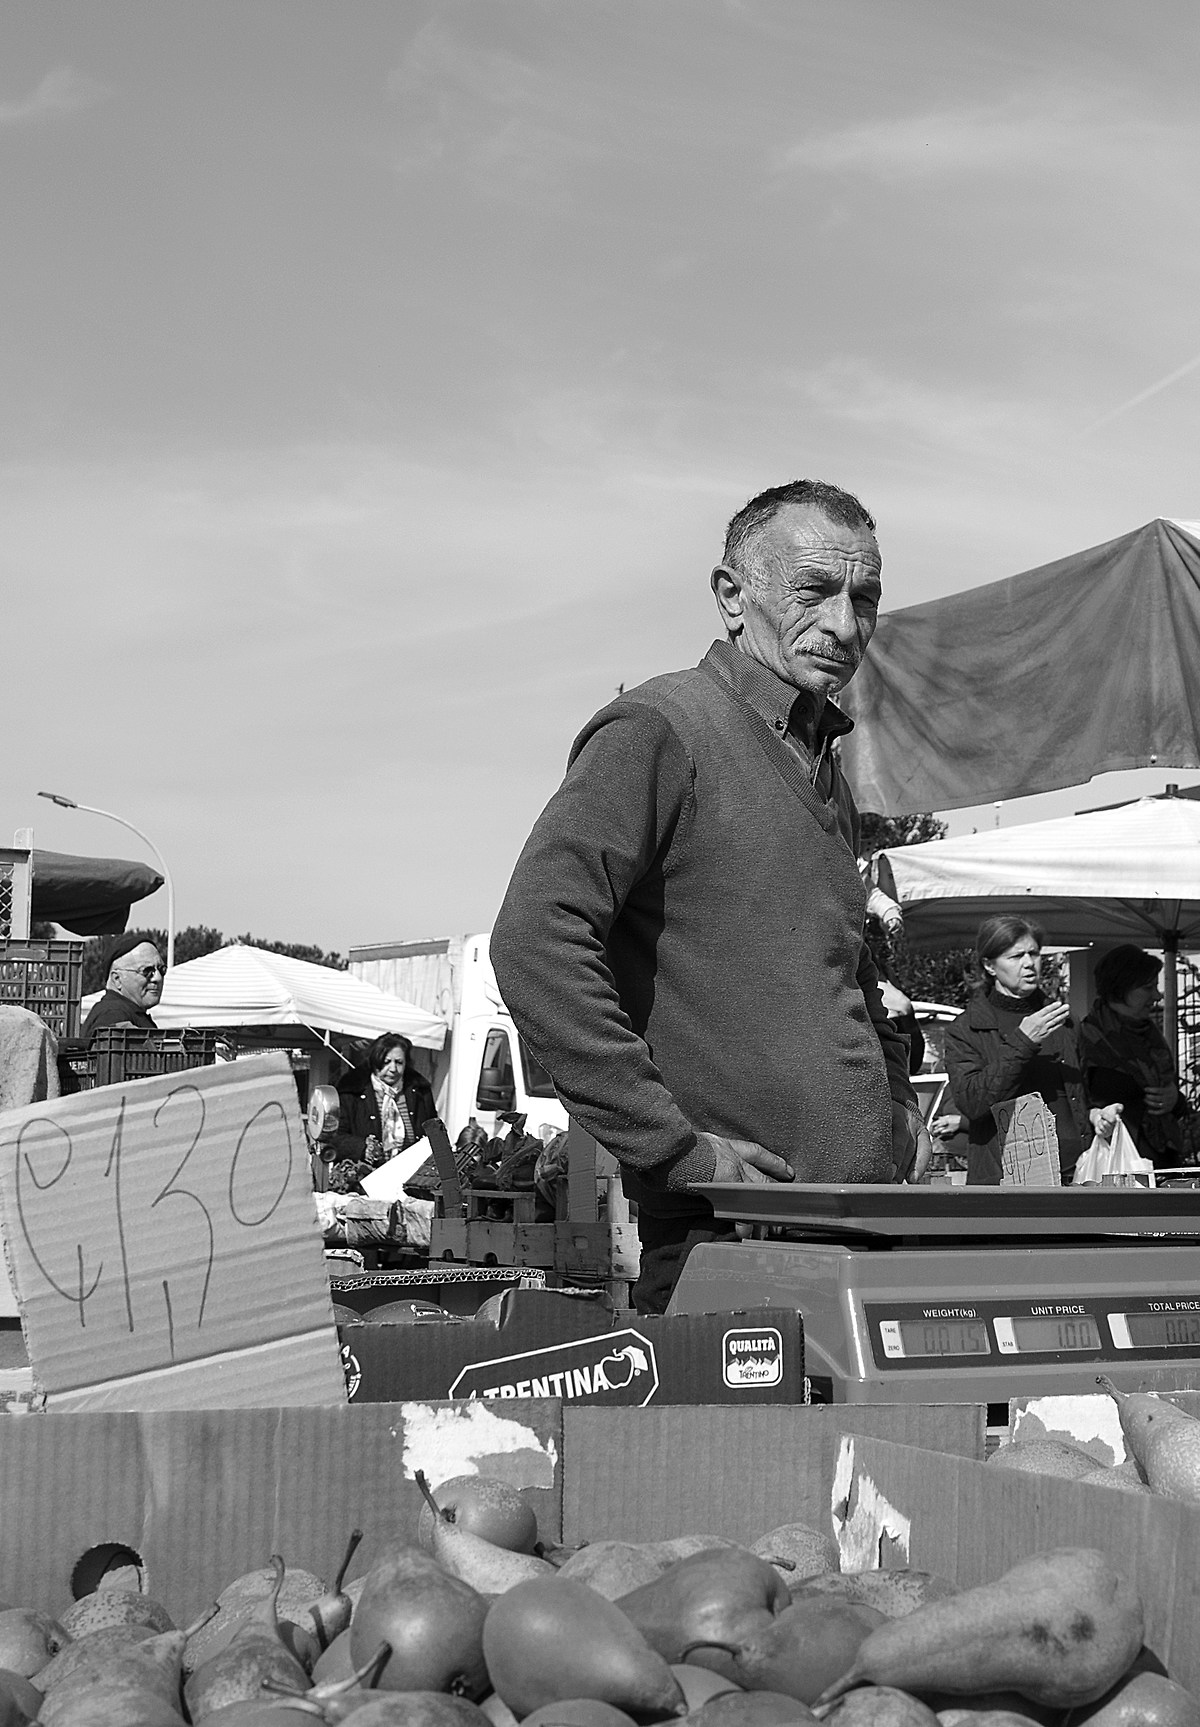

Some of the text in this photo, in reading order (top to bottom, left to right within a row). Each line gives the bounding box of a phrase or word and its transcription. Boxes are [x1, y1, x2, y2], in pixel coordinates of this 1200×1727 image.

[1031, 1304, 1086, 1316] UNIT PRICE
[1148, 1301, 1200, 1312] TOTAL PRICE
[922, 1308, 977, 1319] WEIGHT(kg)
[729, 1336, 776, 1355] QUALITÀ
